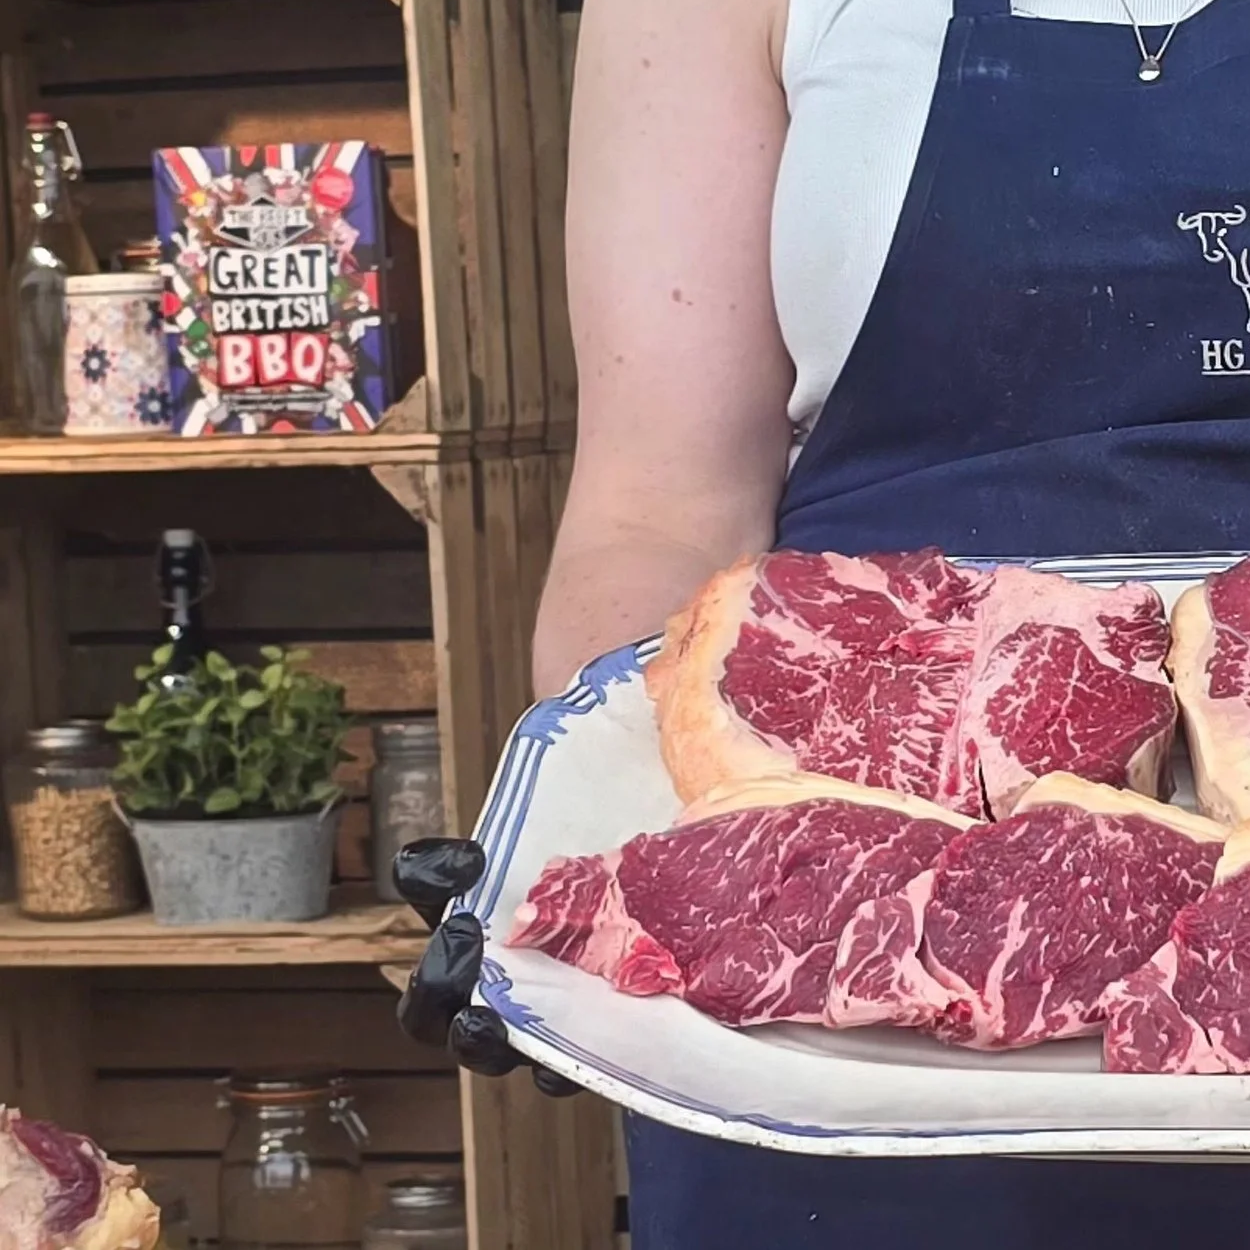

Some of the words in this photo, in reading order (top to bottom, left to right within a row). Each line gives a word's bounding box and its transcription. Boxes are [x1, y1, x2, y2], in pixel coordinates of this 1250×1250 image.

[213, 251, 323, 291] GREAT
[213, 297, 328, 332] BRITISH
[223, 336, 323, 382] BBQ
[1201, 340, 1245, 370] HG
